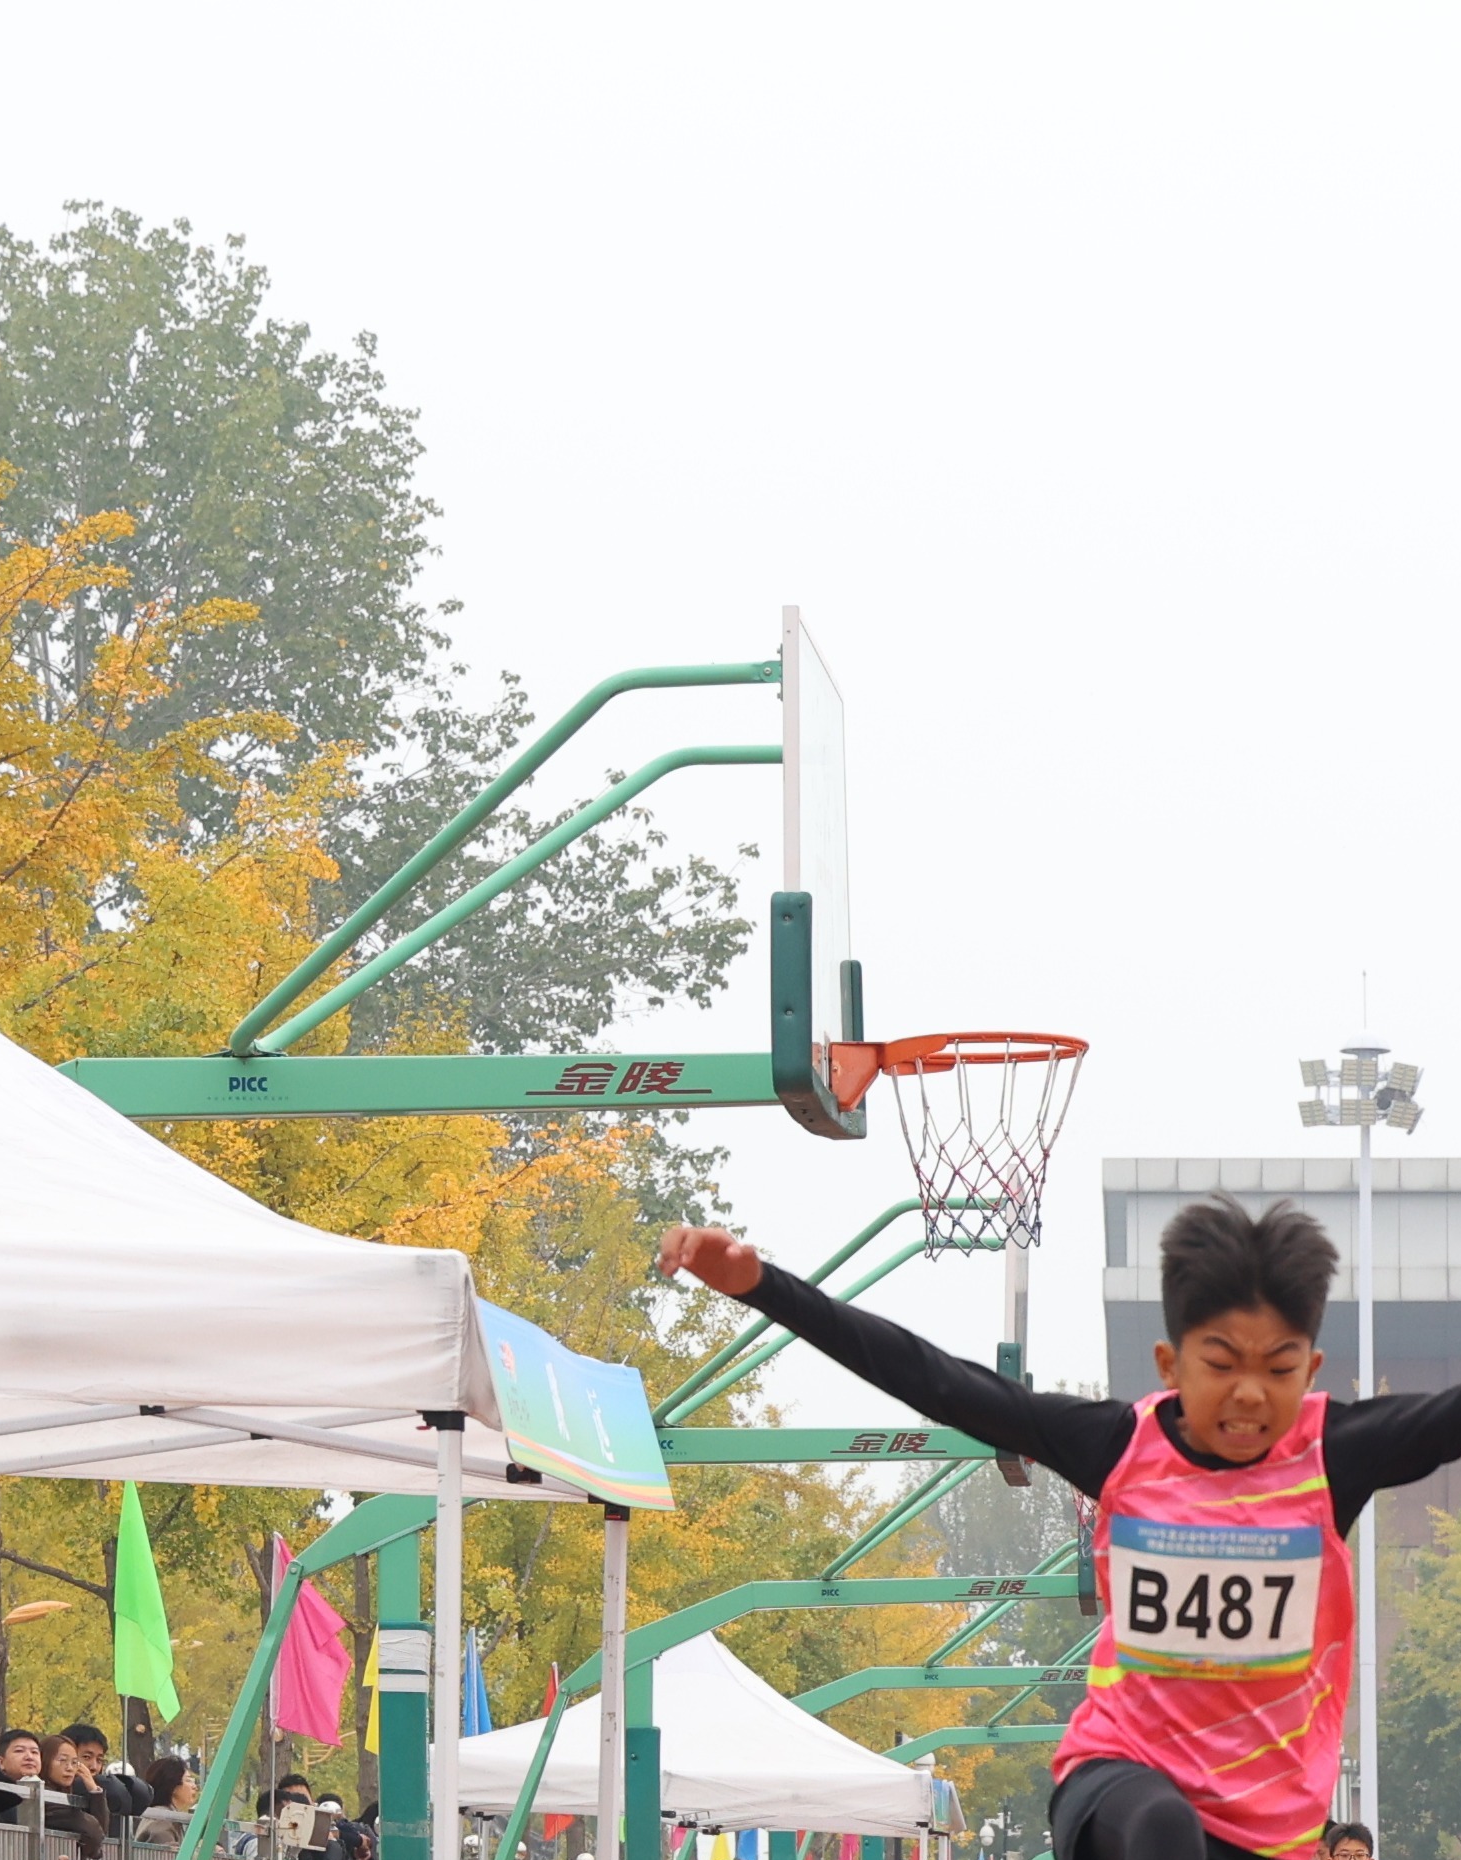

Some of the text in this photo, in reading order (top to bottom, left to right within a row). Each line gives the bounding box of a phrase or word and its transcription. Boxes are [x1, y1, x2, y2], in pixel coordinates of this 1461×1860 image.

[228, 1076, 268, 1092] PICC
[525, 1061, 712, 1096] 金陵
[830, 1432, 948, 1454] 金陵
[955, 1579, 1041, 1597] 金陵
[1129, 1565, 1295, 1640] B487
